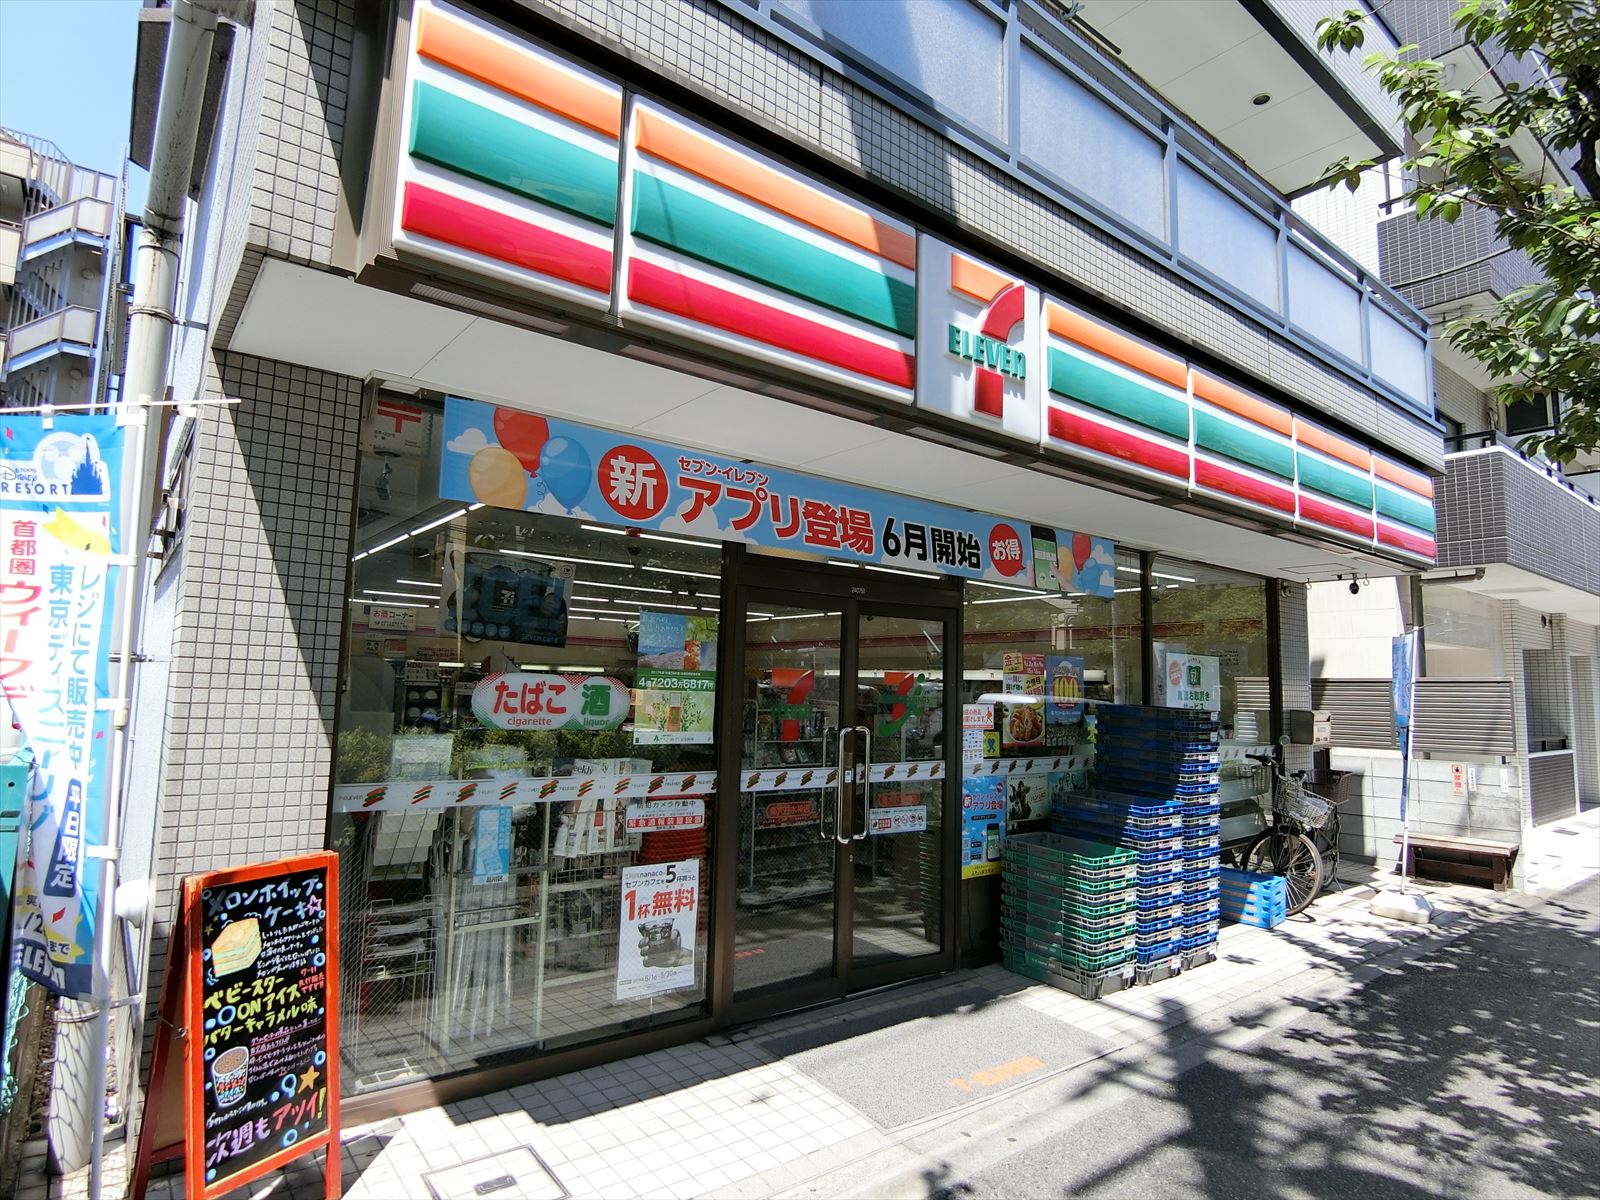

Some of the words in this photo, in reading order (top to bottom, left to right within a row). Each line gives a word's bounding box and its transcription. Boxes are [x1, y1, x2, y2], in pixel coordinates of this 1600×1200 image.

[1, 482, 68, 495] RESORT
[609, 455, 657, 510] 新
[679, 476, 875, 555] アプリ登場
[882, 518, 982, 570] 6月開始
[9, 519, 38, 576] 首都圏
[991, 538, 1021, 562] お得
[66, 565, 101, 769] レジにて販売中
[493, 680, 567, 715] たばこ
[580, 684, 611, 717] 酒
[507, 716, 552, 727] cigarette
[583, 716, 610, 727] liquor
[636, 800, 696, 810] 防犯カメラ作動中
[50, 785, 81, 889] 平日限定
[665, 864, 677, 883] 5
[208, 877, 323, 917] メロンホイップ
[264, 901, 307, 927] ケーキ
[624, 887, 696, 921] 1杯無料
[204, 975, 285, 1010] ベビースター
[204, 996, 318, 1046] バターキャラメル味
[206, 1117, 271, 1168] 次週も
